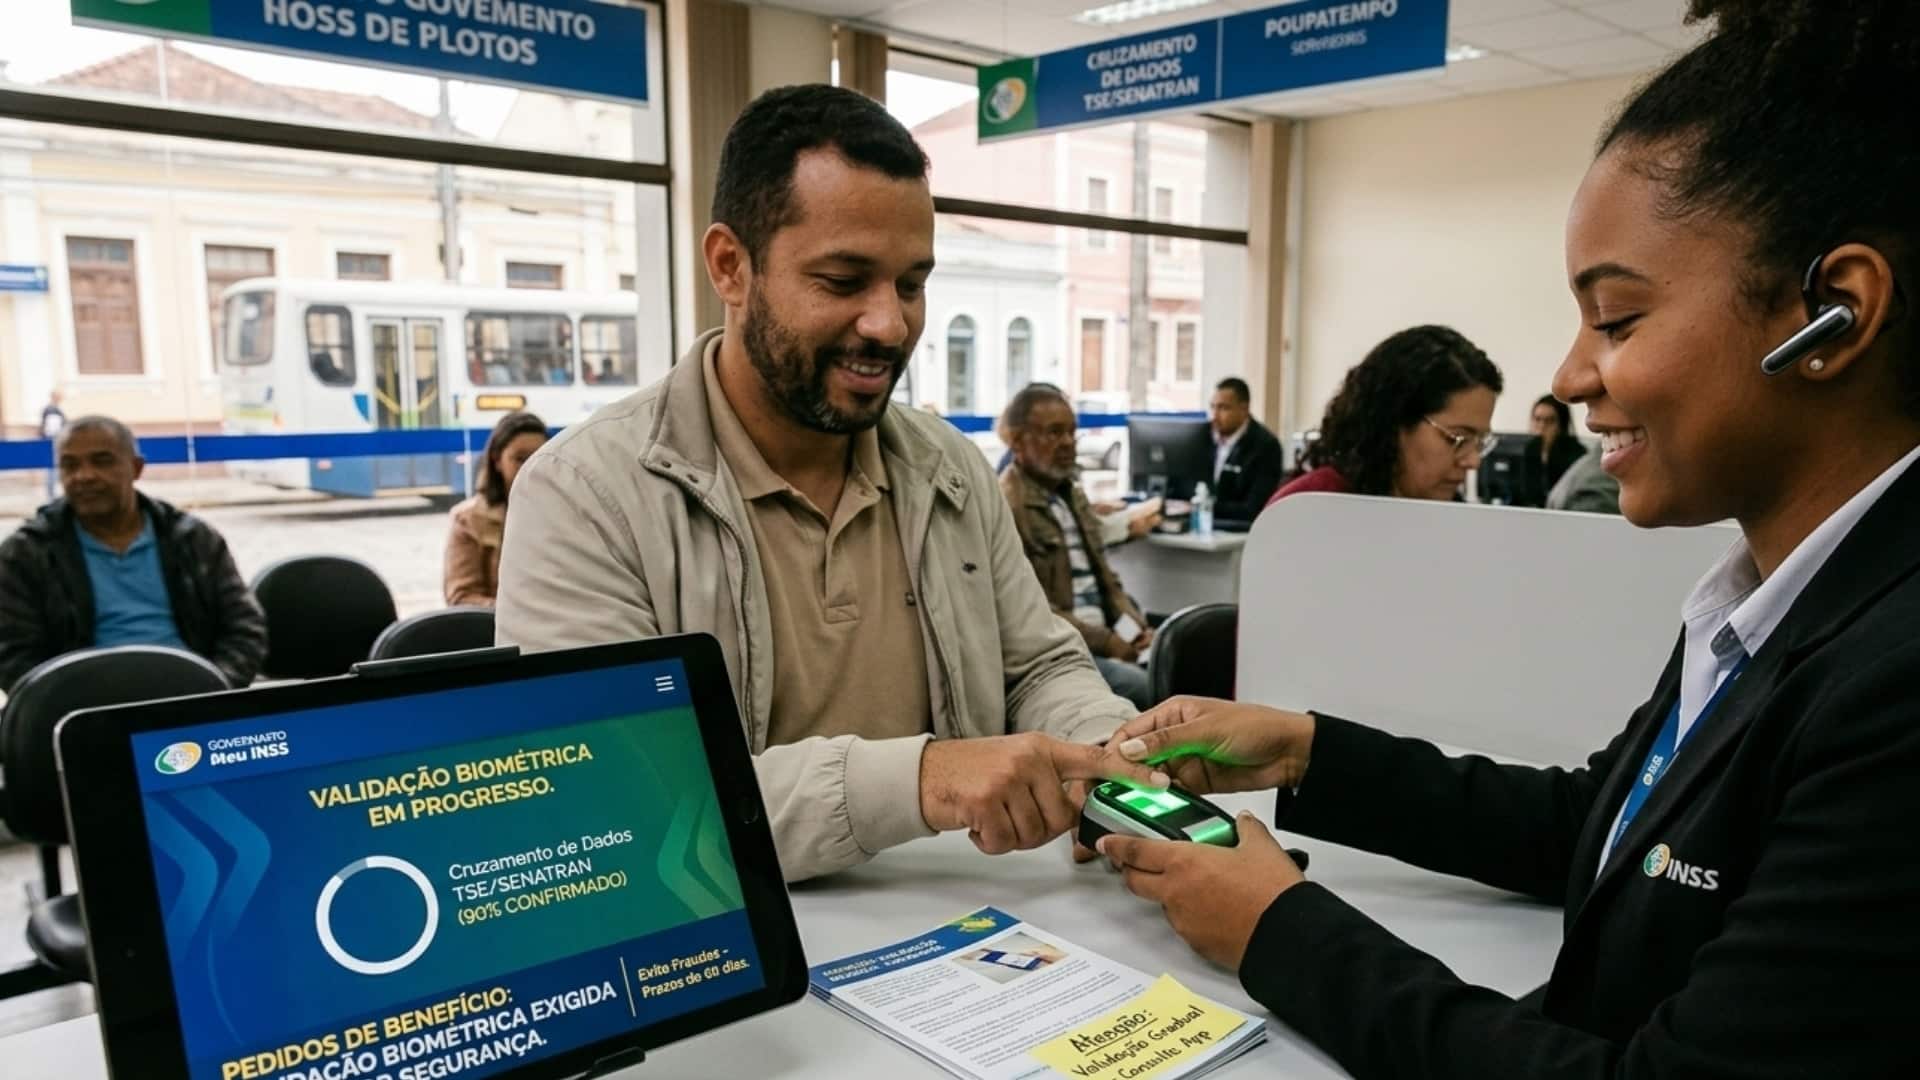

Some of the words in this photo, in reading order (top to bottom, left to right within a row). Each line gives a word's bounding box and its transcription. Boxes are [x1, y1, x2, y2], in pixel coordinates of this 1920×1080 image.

[263, 0, 357, 37] HOSS
[365, 12, 410, 46] DE
[419, 21, 538, 65] PLOTOS
[1264, 0, 1398, 38] POUPATEMPO
[1087, 33, 1197, 70] CRUZAMENTO
[1101, 69, 1121, 88] DE
[1125, 58, 1182, 84] DADOS
[1084, 75, 1199, 111] TSE/SENATRAN
[251, 742, 289, 760] INSS
[309, 766, 450, 809] VALIDAÇÃO
[455, 743, 593, 783] BIOMÉTRICA
[368, 803, 406, 828] EM
[411, 777, 555, 818] PROGRESSO.
[449, 848, 553, 880] Cruzamento
[557, 840, 578, 857] de
[581, 830, 633, 851] Dados
[1666, 858, 1719, 891] INSS
[452, 858, 592, 902] TSE/SENATRAN
[505, 871, 627, 914] CONFIRMADO)
[642, 978, 685, 999] Prazos
[222, 1034, 340, 1080] PEDIDOS
[344, 1022, 380, 1049] DE
[384, 986, 513, 1039] BENEFÍCIO:
[382, 1006, 527, 1066] BIOMÉTRICA
[531, 981, 617, 1020] EXIGIDA
[399, 1030, 547, 1080] SEGURANÇA.
